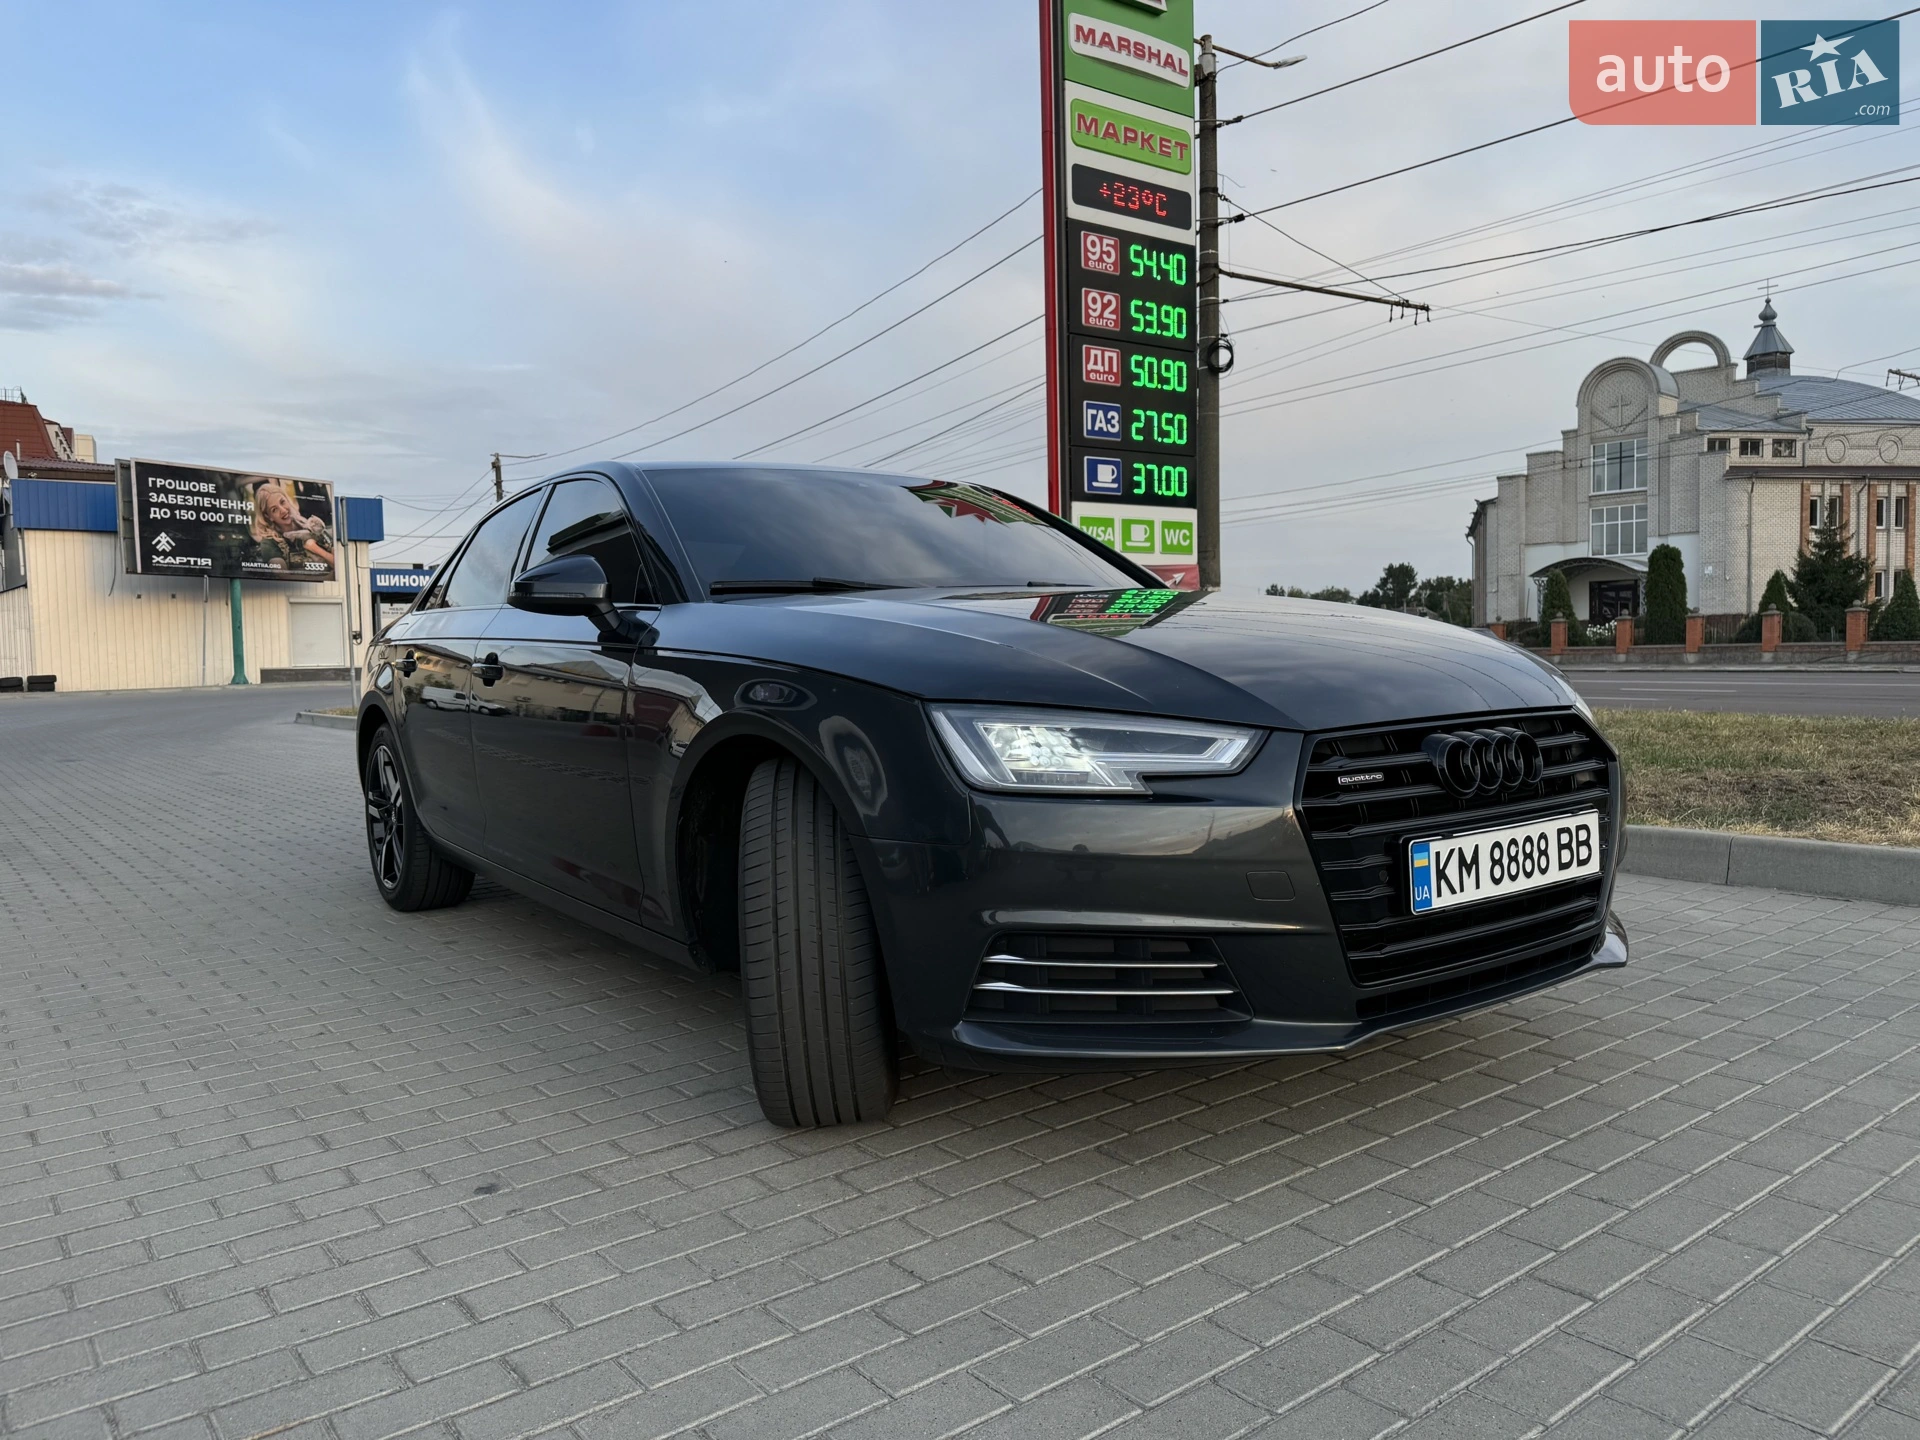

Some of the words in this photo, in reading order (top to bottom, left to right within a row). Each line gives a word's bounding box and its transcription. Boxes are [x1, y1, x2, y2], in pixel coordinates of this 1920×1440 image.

[1074, 24, 1188, 78] MARSHAL
[1076, 113, 1188, 161] МАРКЕТ
[1086, 235, 1116, 264] 95
[1088, 259, 1114, 272] euro
[1130, 244, 1187, 286] 54.40
[1087, 291, 1117, 320] 92
[1089, 317, 1115, 328] euro
[1130, 300, 1187, 339] 53.90
[1087, 349, 1118, 373] ДП
[1130, 354, 1188, 393] 50.90
[1089, 371, 1115, 382] euro
[1086, 408, 1120, 434] ГАЗ
[1131, 409, 1188, 445] 27.50
[148, 477, 216, 493] ГРОШОВЕ
[1132, 463, 1188, 497] 37.00
[149, 492, 255, 512] ЗАБЕЗПЕЧЕННЯ
[149, 507, 171, 520] ДО
[174, 510, 197, 522] 150
[199, 512, 225, 524] 000
[227, 514, 253, 525] ГРН
[1164, 529, 1190, 546] WC
[152, 555, 212, 566] ХАРТІЯ
[1341, 774, 1383, 783] quattro
[1434, 843, 1480, 898] KM
[1489, 831, 1550, 886] 8888
[1556, 823, 1593, 872] BB
[1414, 884, 1431, 901] UA
